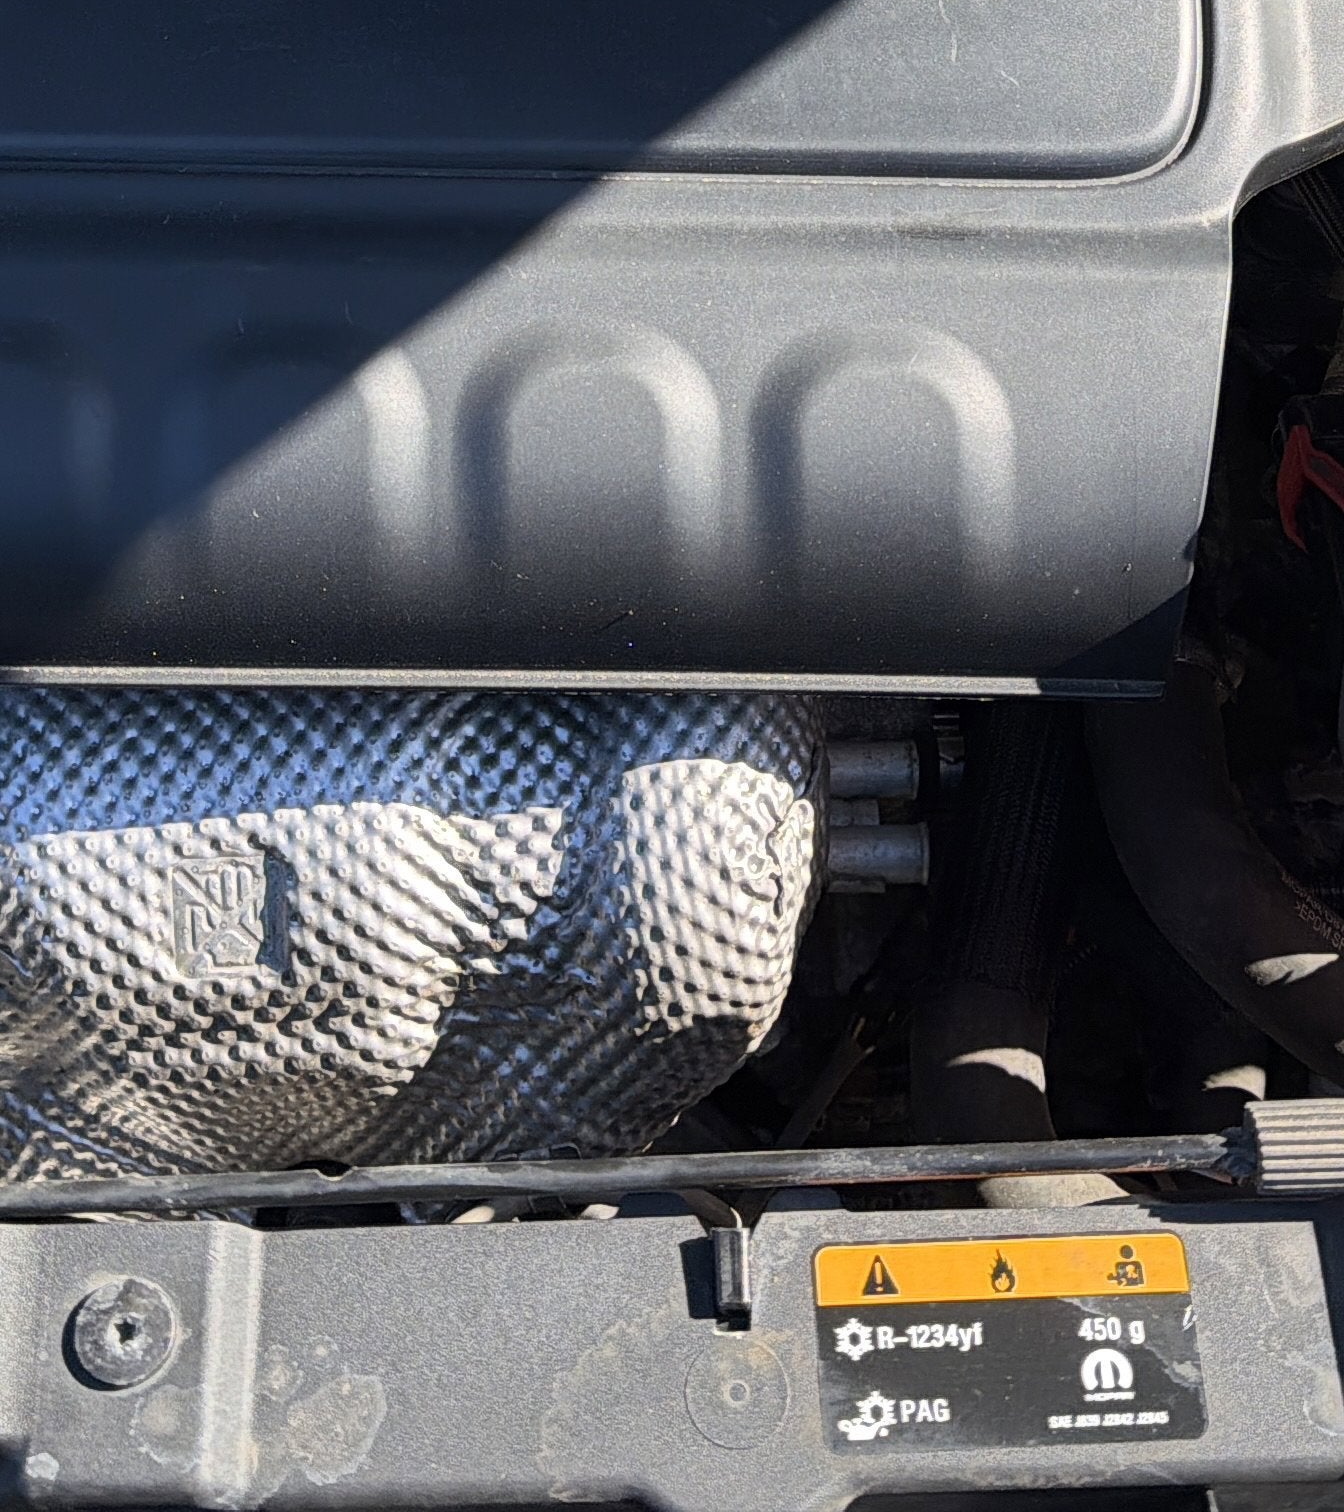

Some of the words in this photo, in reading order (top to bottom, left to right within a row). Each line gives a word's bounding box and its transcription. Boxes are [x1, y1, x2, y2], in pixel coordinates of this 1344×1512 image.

[876, 1321, 984, 1352] R-1234yf
[1078, 1317, 1122, 1342] 450
[1129, 1320, 1145, 1345] g
[900, 1398, 951, 1424] PAG
